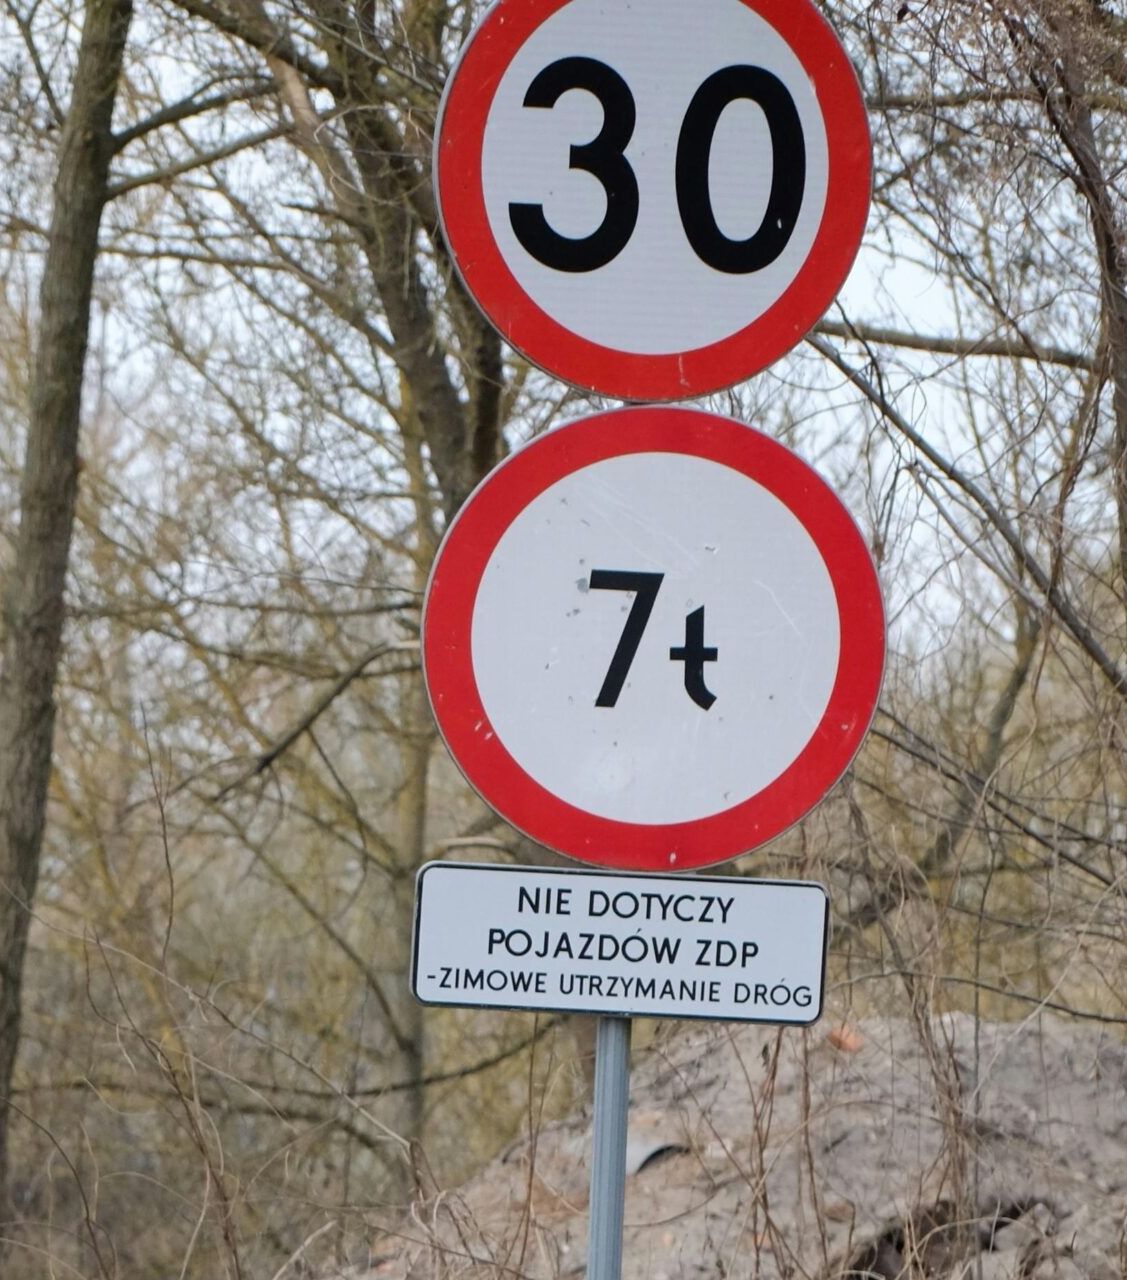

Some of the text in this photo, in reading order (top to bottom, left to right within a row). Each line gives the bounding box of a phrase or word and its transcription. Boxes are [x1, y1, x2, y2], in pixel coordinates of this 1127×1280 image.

[508, 56, 806, 275] 30
[588, 569, 718, 712] 7t
[518, 886, 735, 924] NIE DOTYCZY
[488, 928, 759, 968] POJAZDÓW ZDP
[427, 967, 812, 1008] -ZIMOWE UTRZYMANIE DRÓG
